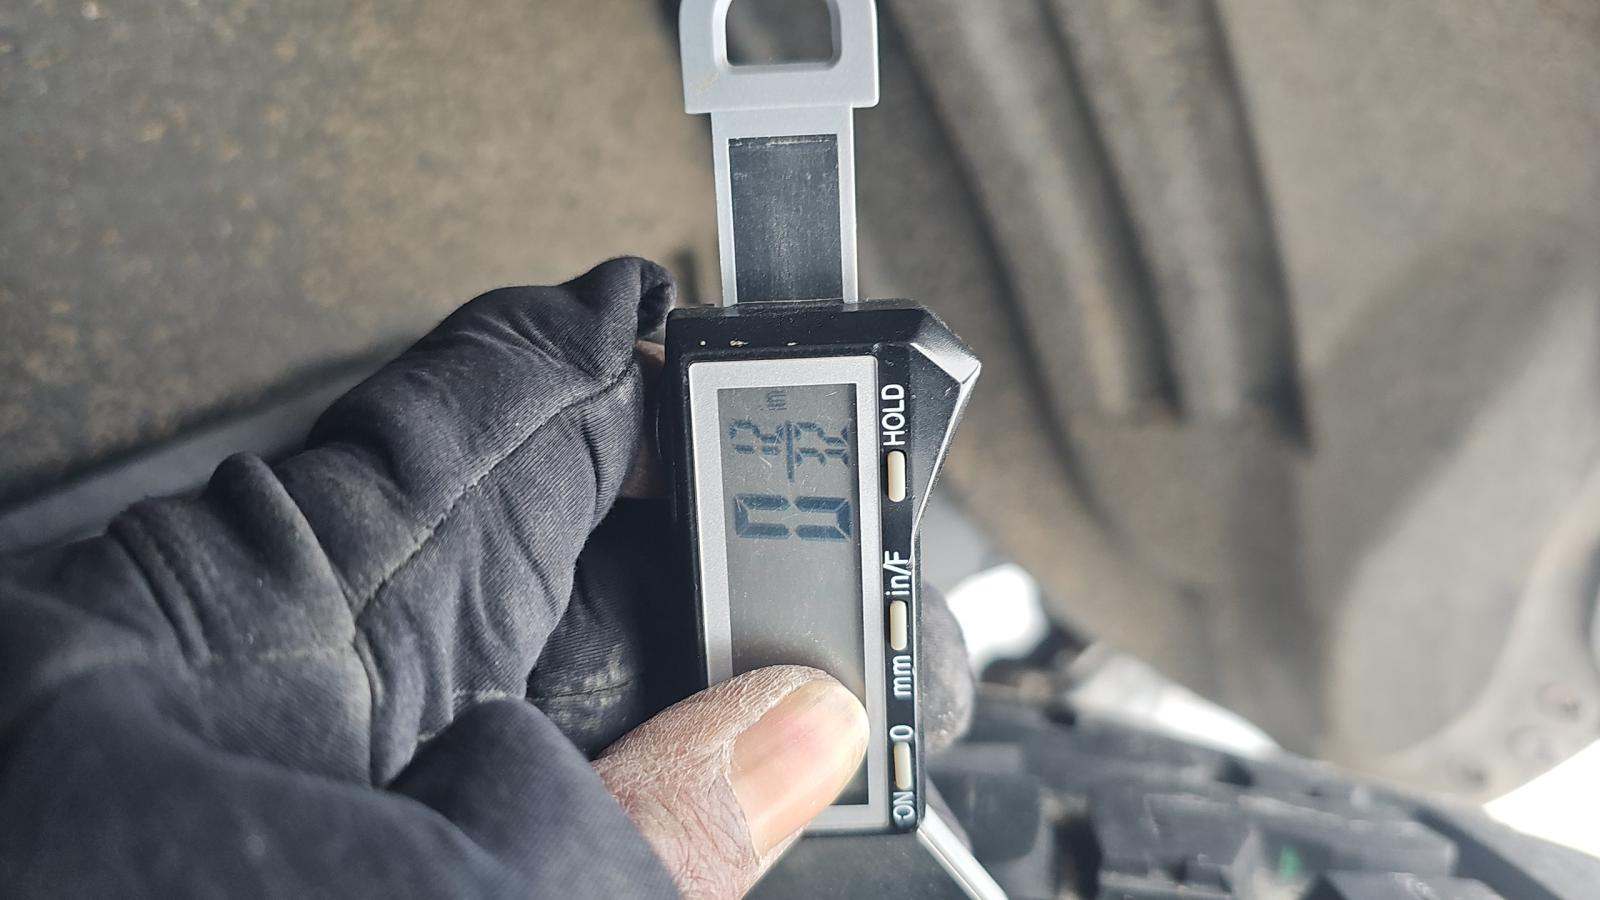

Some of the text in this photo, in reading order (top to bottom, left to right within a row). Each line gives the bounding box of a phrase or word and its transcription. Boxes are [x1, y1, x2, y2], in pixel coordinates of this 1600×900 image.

[880, 384, 905, 446] HOLD
[734, 493, 851, 541] 0
[883, 550, 912, 596] in/F
[892, 655, 912, 698] mm
[892, 791, 916, 827] ON
